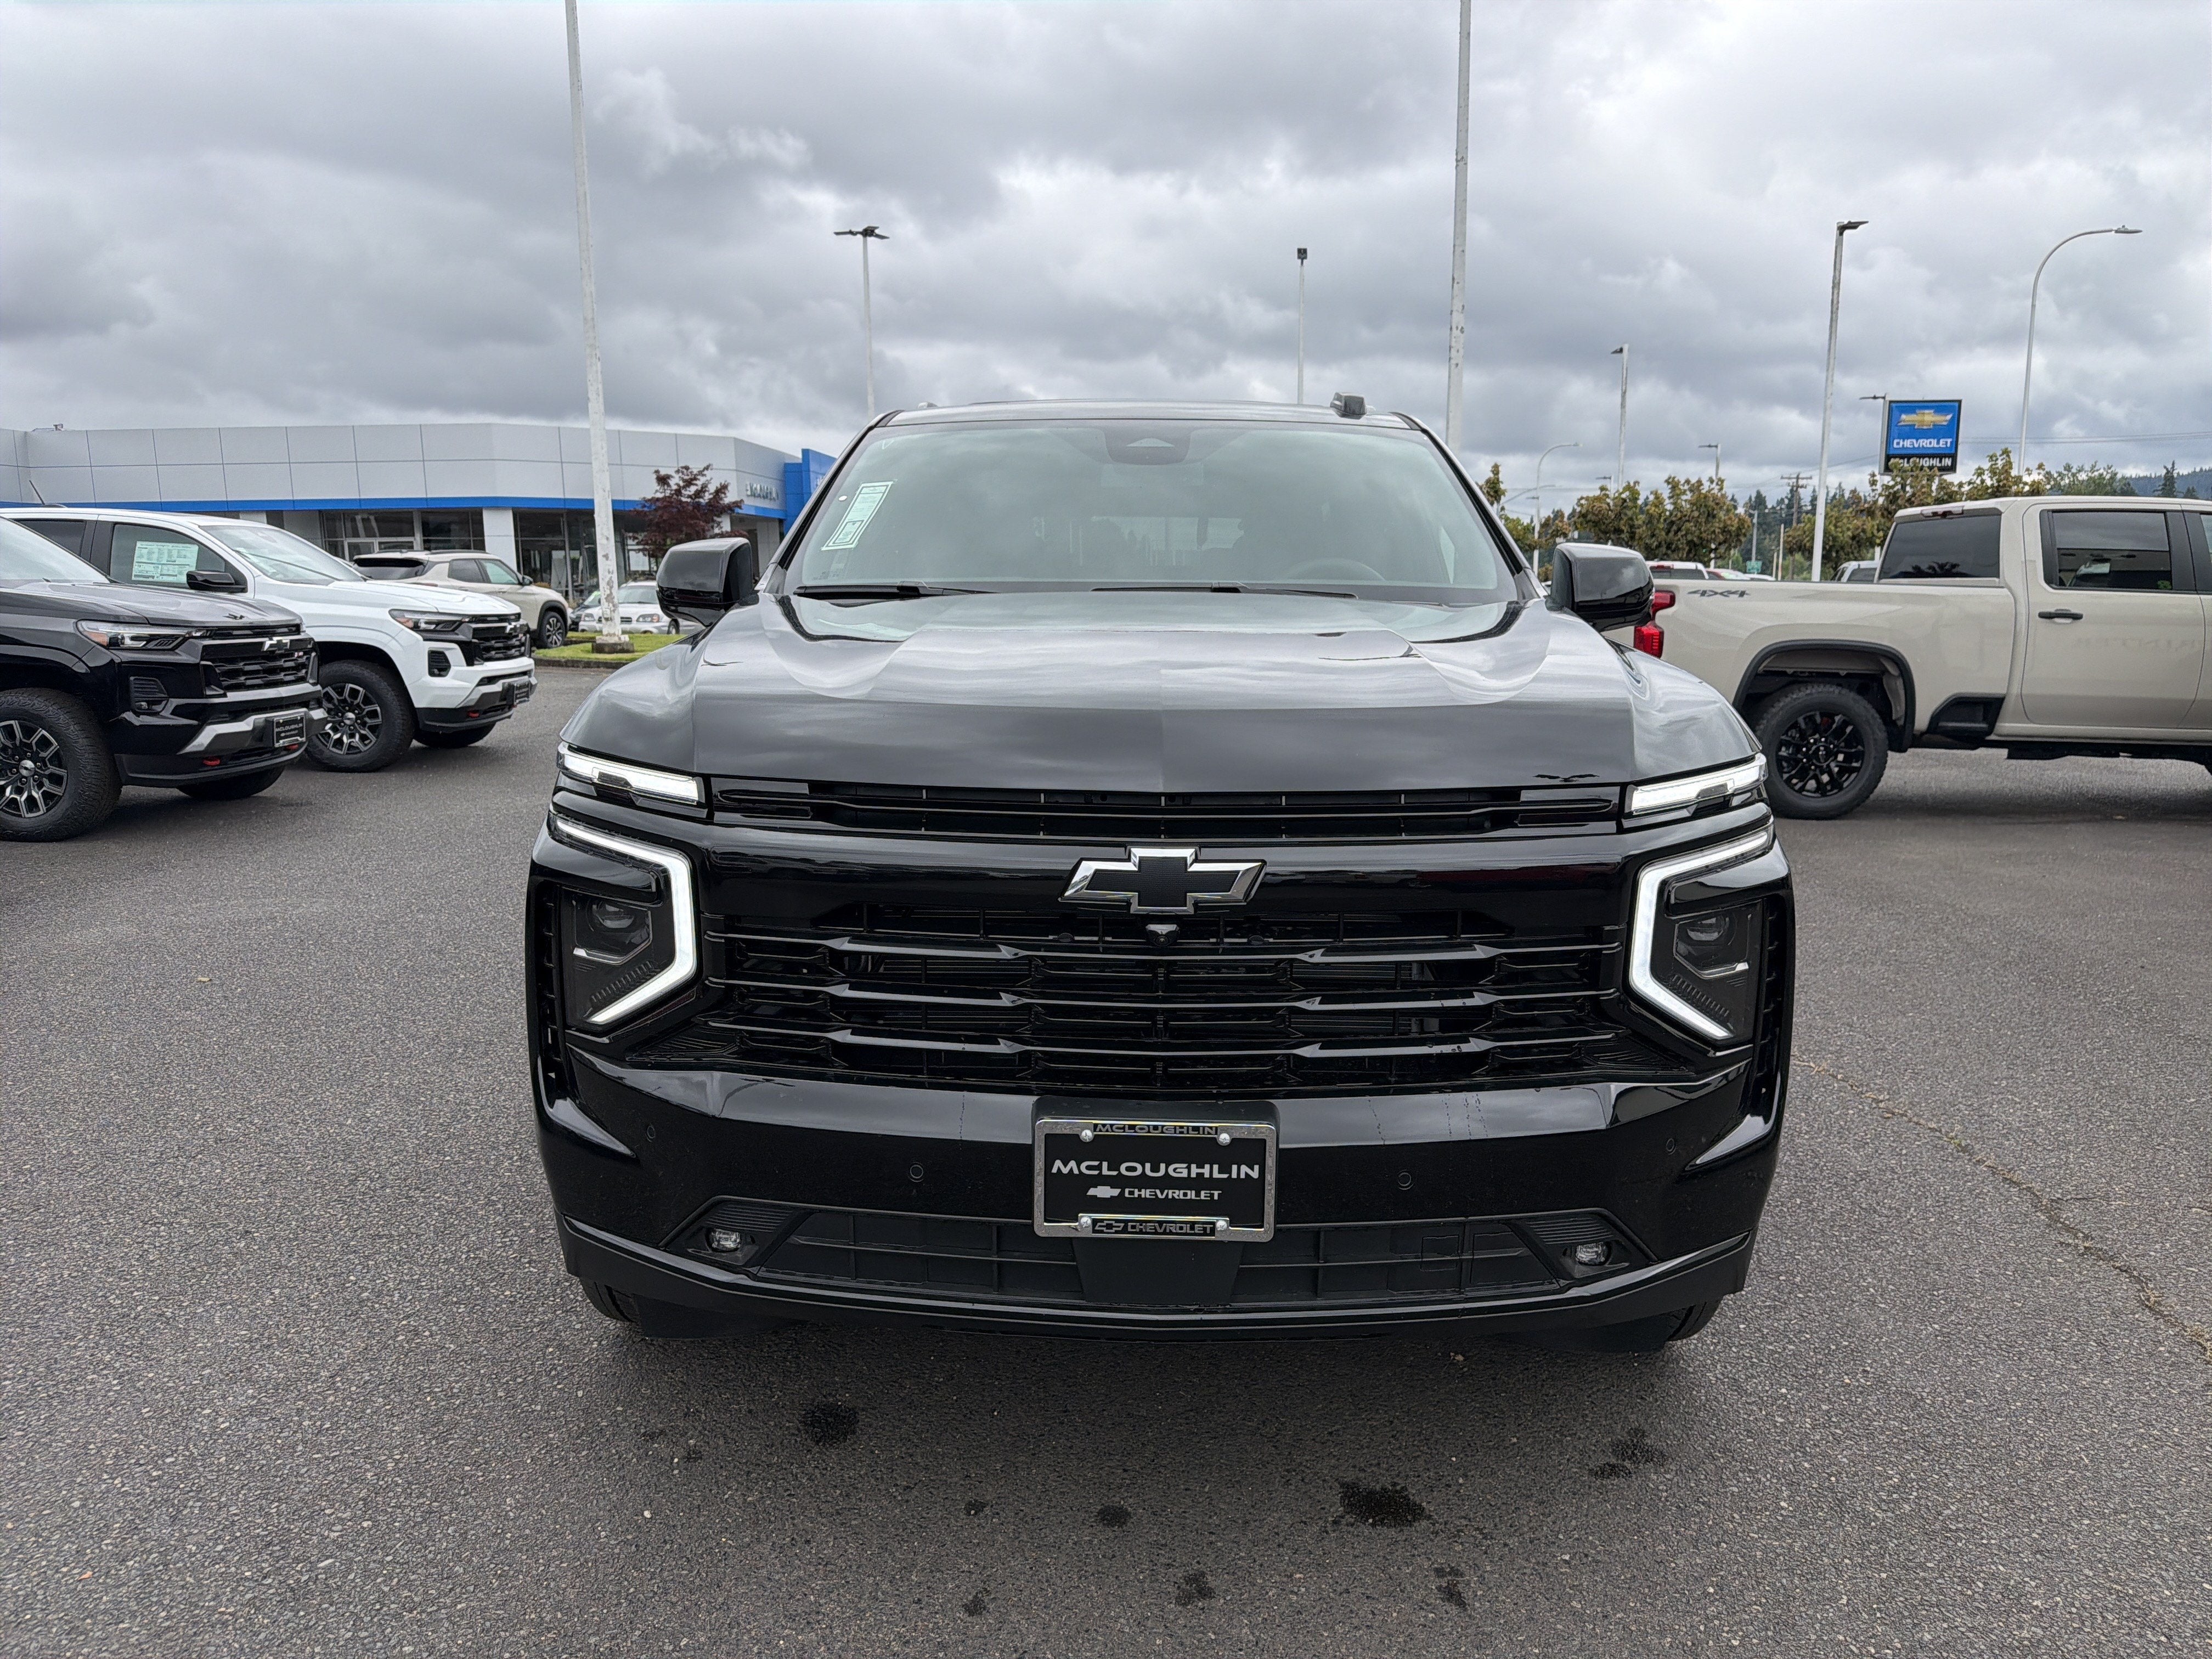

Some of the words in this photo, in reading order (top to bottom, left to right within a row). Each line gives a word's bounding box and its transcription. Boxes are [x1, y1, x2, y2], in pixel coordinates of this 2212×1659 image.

[1893, 438, 1952, 448] CHEVROLET
[1096, 1124, 1216, 1135] MCLOUGHLIN
[1051, 1159, 1260, 1179] MCLOUGHLIN
[1124, 1188, 1222, 1200] CHEVROLET
[1127, 1222, 1214, 1234] CHEVROLET
